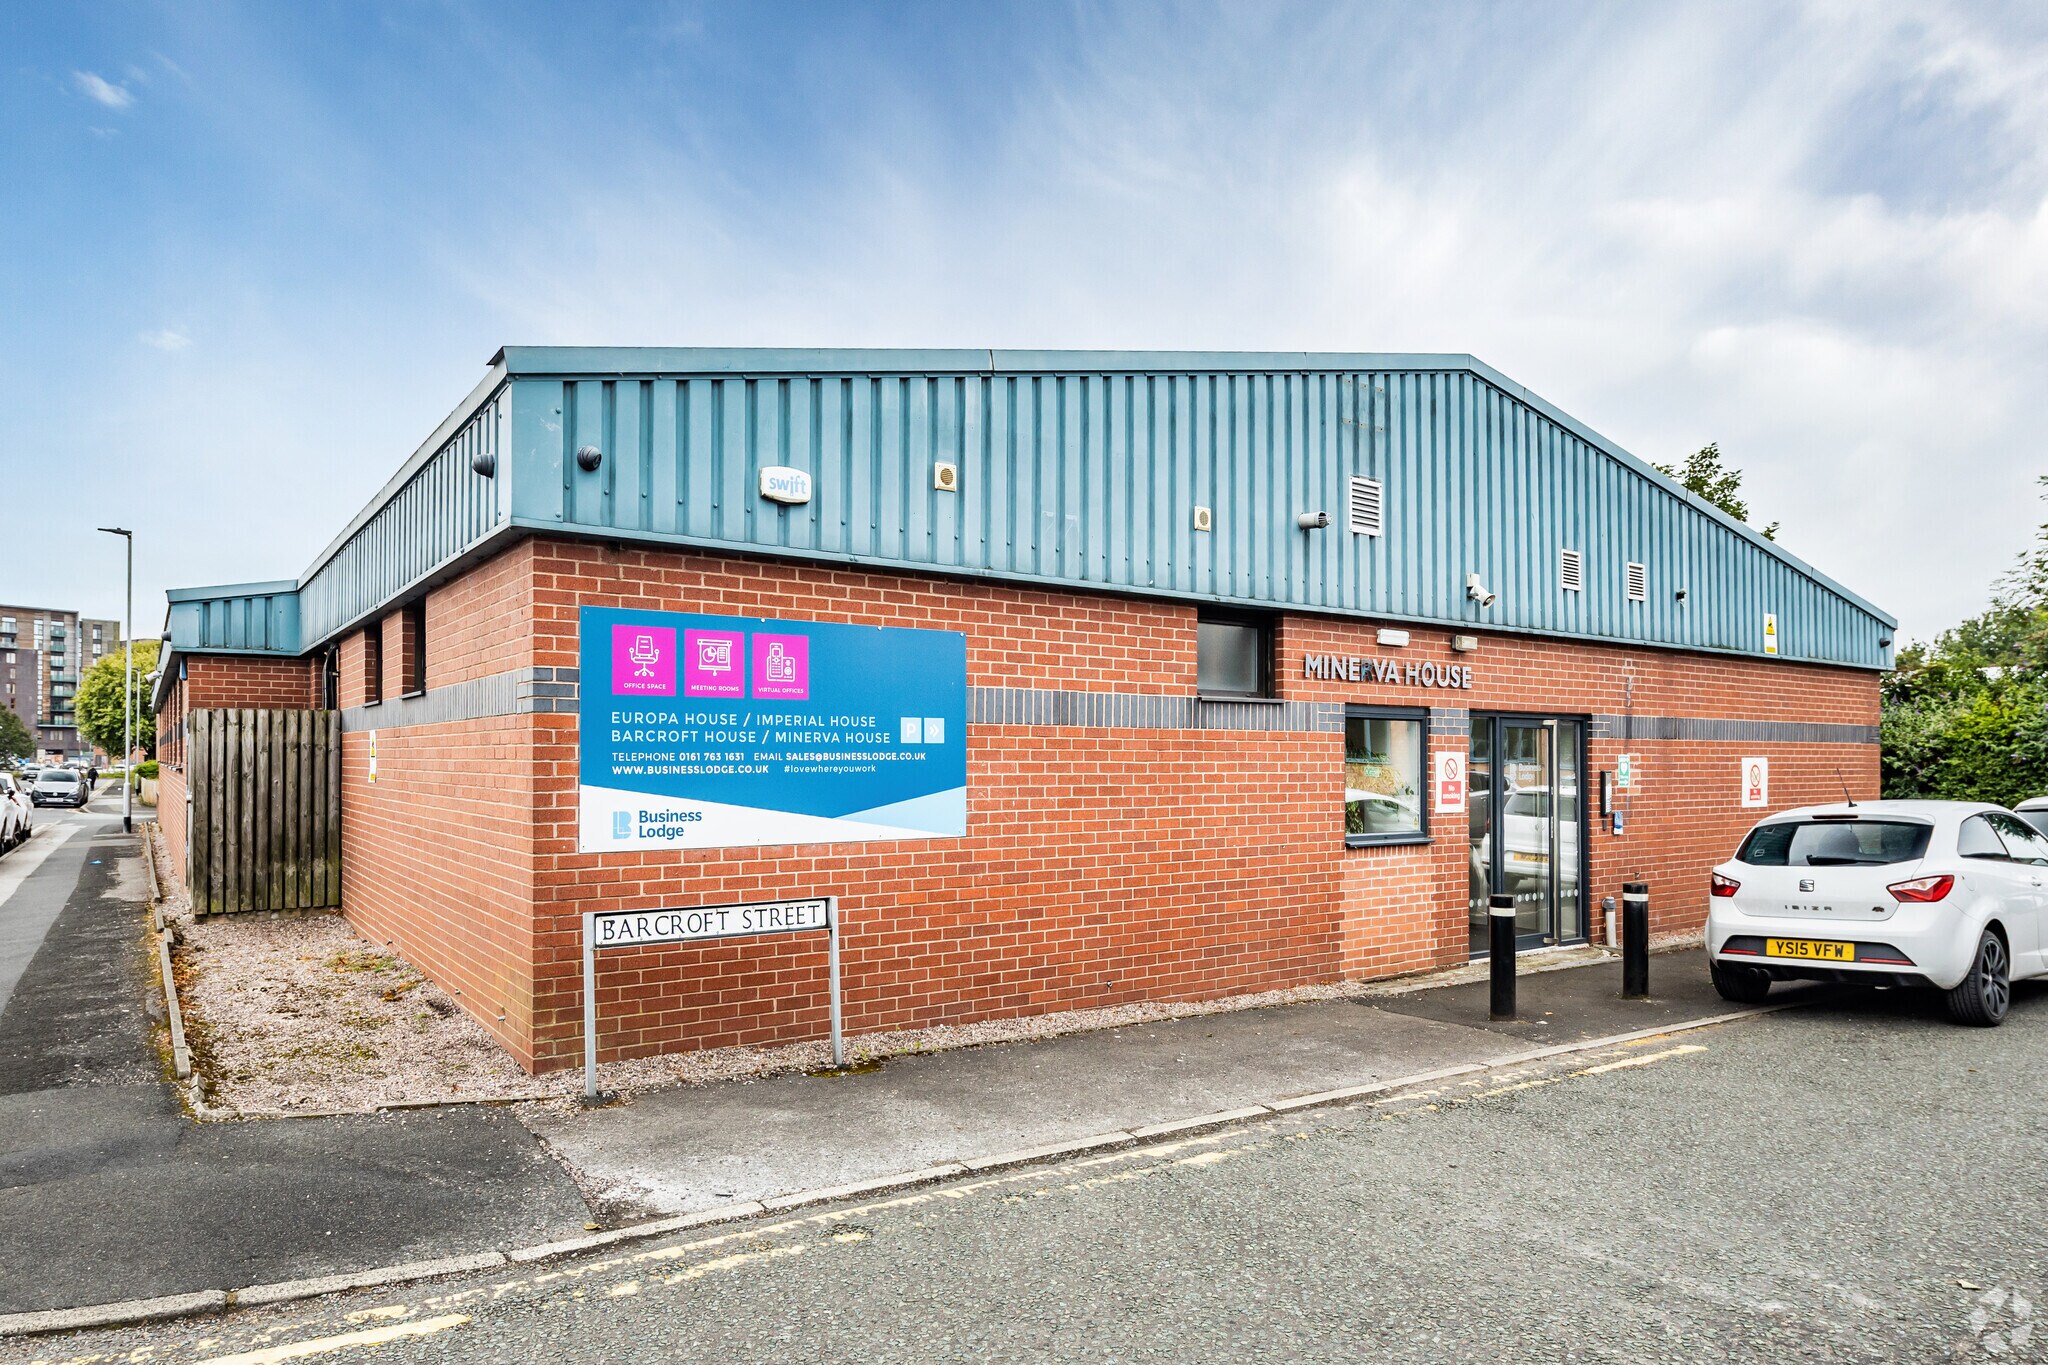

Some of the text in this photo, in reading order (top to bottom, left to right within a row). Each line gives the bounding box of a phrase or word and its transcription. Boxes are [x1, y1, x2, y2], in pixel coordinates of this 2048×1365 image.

[769, 475, 807, 497] swift
[1305, 653, 1473, 689] MINERVA HOUSE
[611, 711, 679, 724] EUROPA
[685, 713, 738, 725] HOUSE
[757, 714, 825, 727] IMPERIAL
[830, 715, 876, 727] HOUSE
[611, 729, 699, 743] BARCROFT
[704, 731, 756, 743] HOUSE
[775, 732, 841, 743] MINERVA
[845, 732, 891, 744] HOUSE
[612, 752, 926, 762] TELEPHONE 0161 763 1631 EMAIL SALES@BUSINESSLODGE.CO.UK
[612, 764, 876, 775] WWW.BUSINESSLODGE.CO.UK #lovewhereyouwork
[638, 808, 702, 824] Business
[638, 824, 684, 840] Lodge
[602, 904, 820, 941] BARCROFT STREET
[1776, 941, 1844, 958] YS15 VFW
